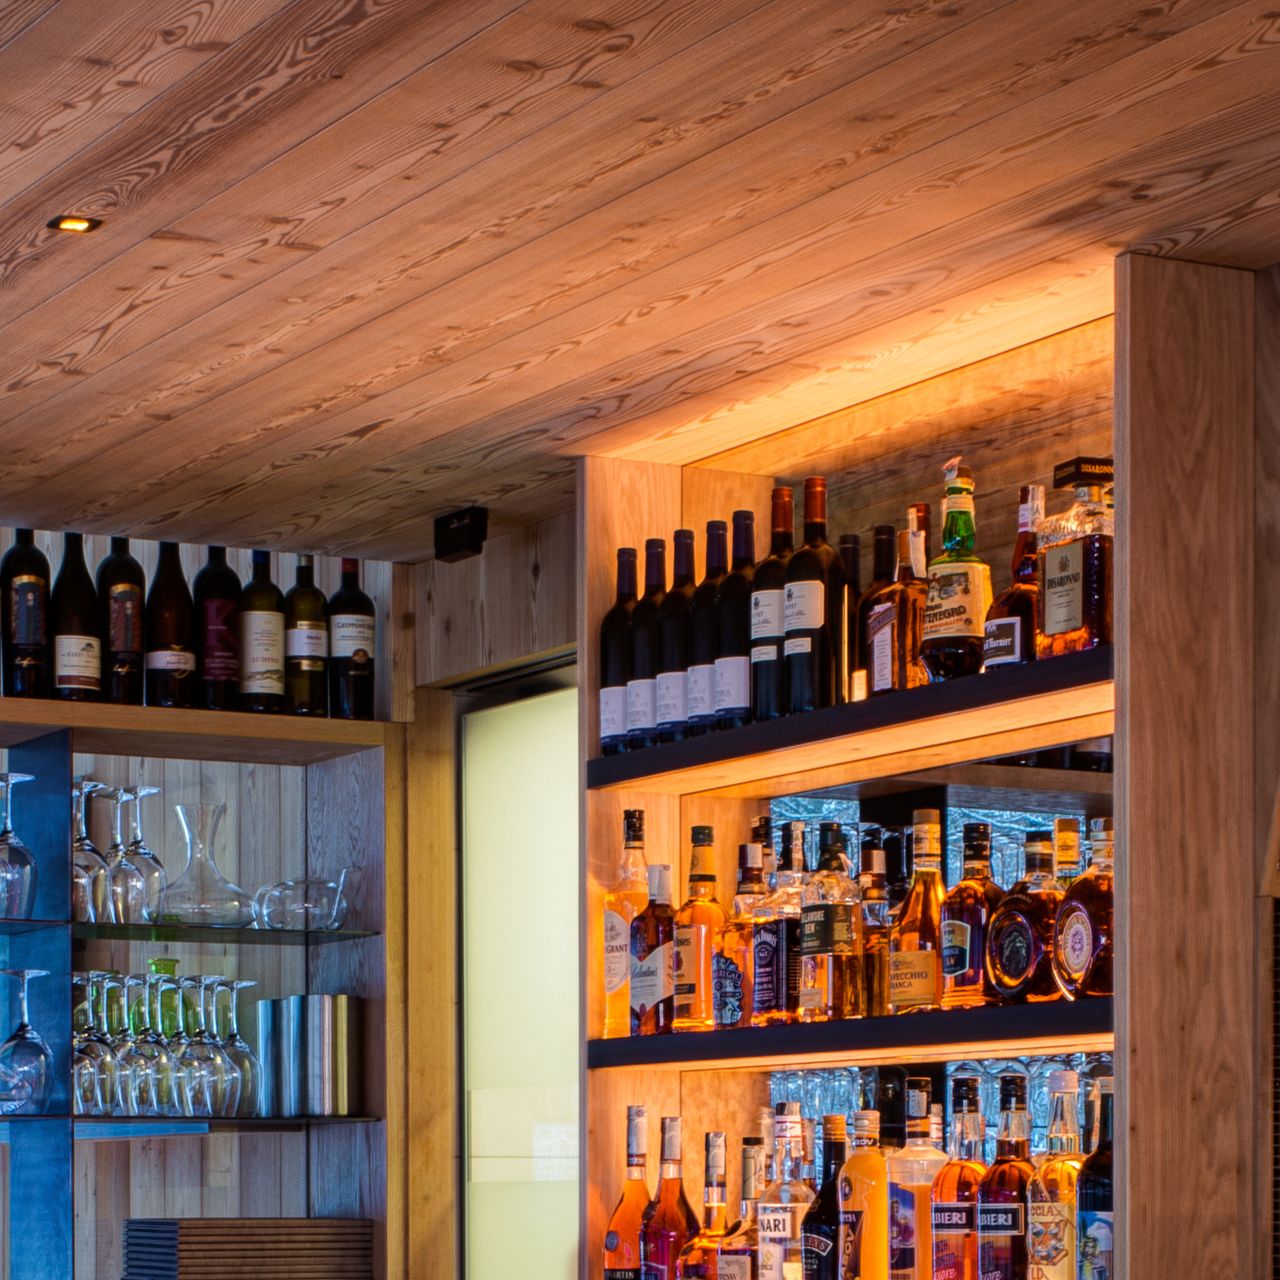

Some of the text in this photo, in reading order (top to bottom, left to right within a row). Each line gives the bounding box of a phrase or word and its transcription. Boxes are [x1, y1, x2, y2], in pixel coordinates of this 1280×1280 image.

[1081, 463, 1114, 474] DISARONN
[934, 1211, 967, 1225] BIERI
[979, 1212, 1013, 1226] BIERI
